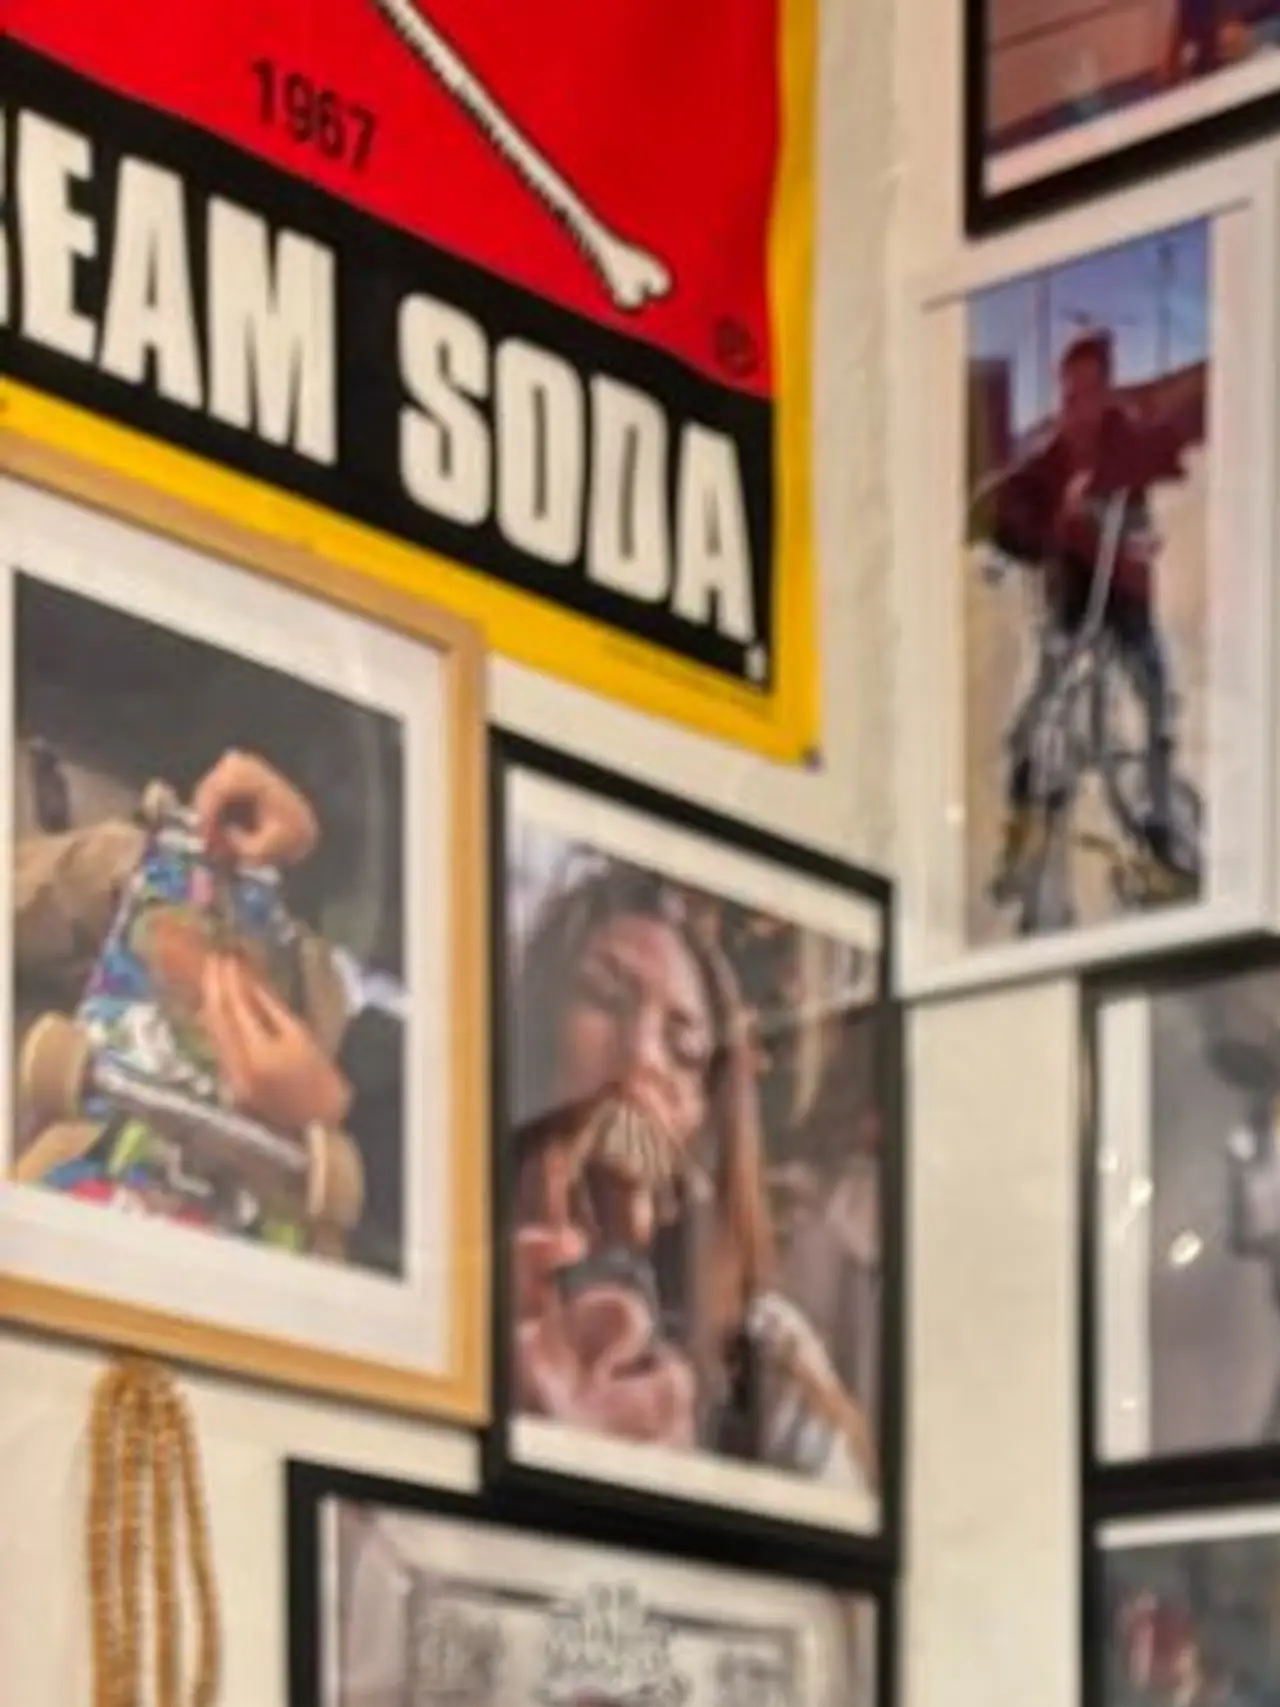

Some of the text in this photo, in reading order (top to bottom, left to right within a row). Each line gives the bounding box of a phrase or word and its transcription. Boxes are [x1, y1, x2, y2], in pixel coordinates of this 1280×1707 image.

[251, 57, 378, 172] 1967
[0, 104, 755, 644] EAM SODA
